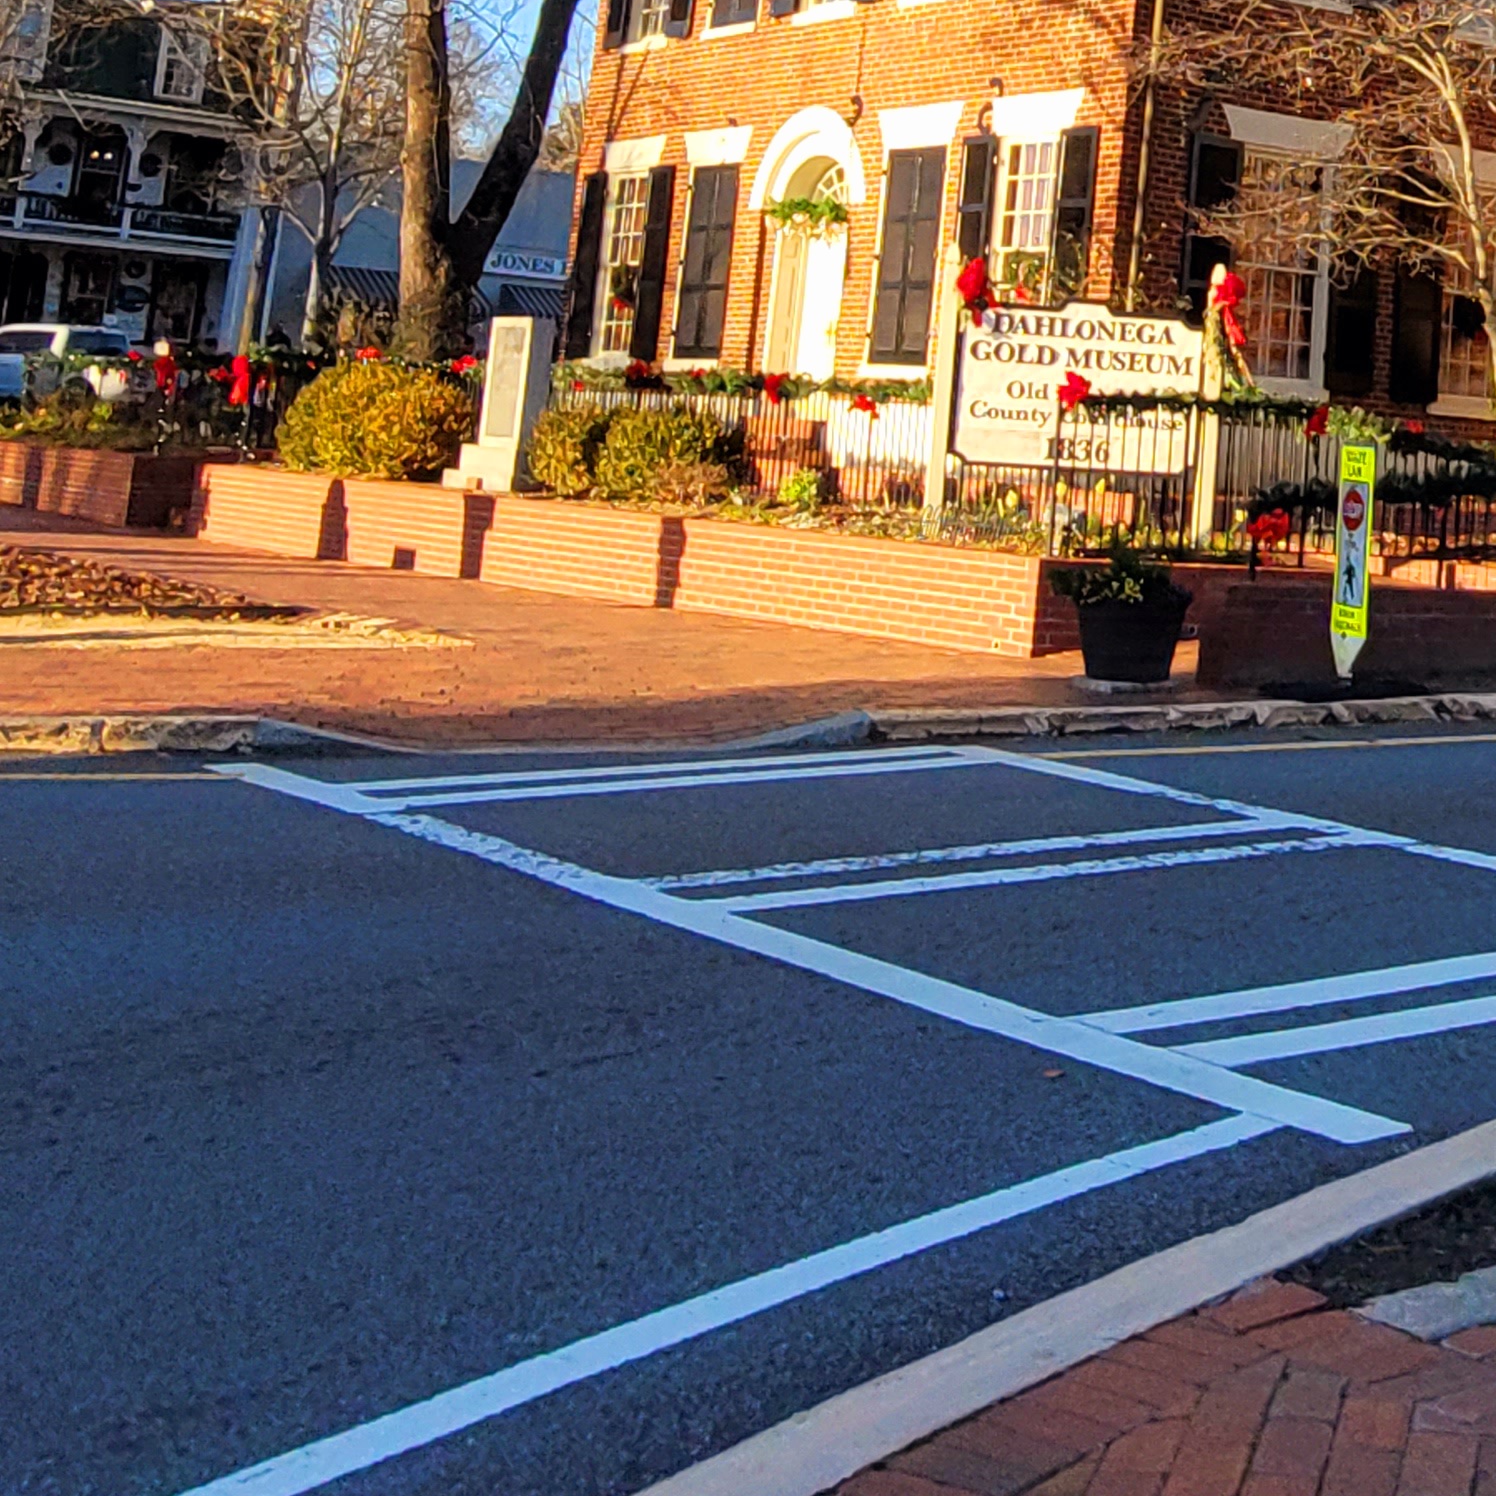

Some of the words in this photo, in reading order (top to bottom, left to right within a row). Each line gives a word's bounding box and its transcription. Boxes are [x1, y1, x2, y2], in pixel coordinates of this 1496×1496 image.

[490, 254, 555, 274] JONES
[992, 311, 1175, 345] DAHLONEGA
[969, 339, 1060, 366] GOLD
[1065, 347, 1194, 377] MUSEUM
[1006, 379, 1049, 400] Old
[969, 400, 1052, 427] County
[1043, 437, 1111, 463] 1836
